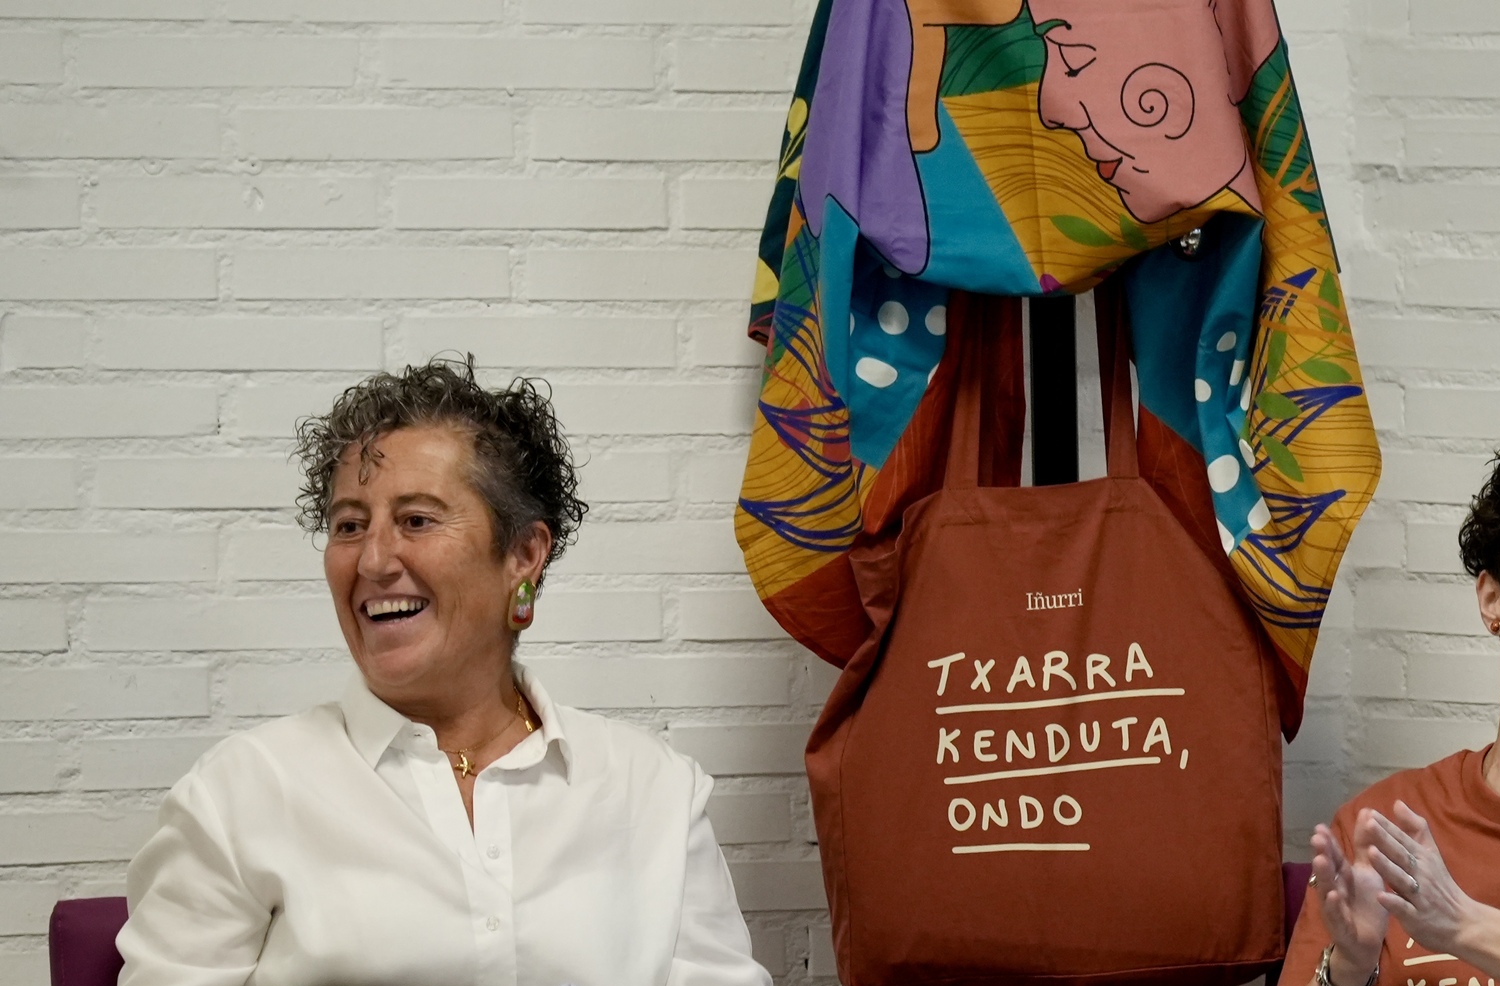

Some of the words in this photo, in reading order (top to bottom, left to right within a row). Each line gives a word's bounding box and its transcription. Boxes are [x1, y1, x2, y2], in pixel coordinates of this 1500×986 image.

[1025, 588, 1084, 611] Iñurri
[927, 641, 1154, 696] TXARRA
[936, 716, 1189, 770] KENDUTA,
[948, 794, 1083, 832] ONDO
